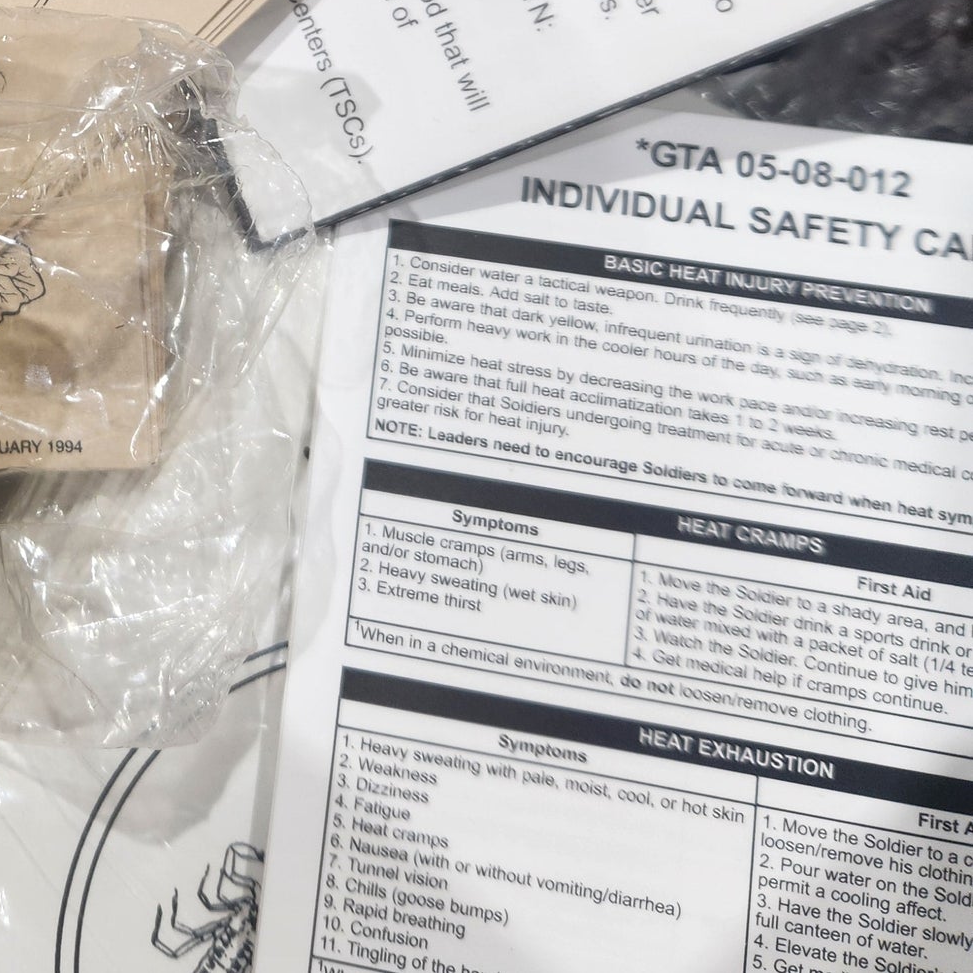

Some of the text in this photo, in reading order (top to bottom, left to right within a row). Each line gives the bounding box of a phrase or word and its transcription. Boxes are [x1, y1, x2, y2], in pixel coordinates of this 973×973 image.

[434, 21, 470, 70] that
[457, 72, 490, 112] will
[319, 76, 373, 165] (TSCs).
[736, 150, 911, 198] 05-08-012
[521, 176, 973, 261] INDIVIDUAL SAFETY CA
[604, 254, 932, 313] BASIC HEAT INJURY PREVENTION
[47, 439, 83, 454] 1994
[452, 509, 539, 537] Symptoms
[678, 516, 824, 554] HEAT CRAMPS
[361, 541, 484, 575] and/or stomach)
[365, 522, 589, 575] 1. Muscle cramps (arms, legs,
[857, 576, 931, 602] First Aid
[639, 727, 834, 779] HEAT EXHAUSTION
[761, 832, 913, 875] loosen/remove his
[763, 814, 959, 865] 1. Move the Soldier to a
[758, 875, 947, 922] permit a cooling affect.
[759, 853, 929, 899] 2. Pour water on the
[755, 911, 928, 960] full canteen of water.
[756, 893, 973, 952] 3. Have the Soldier slowly
